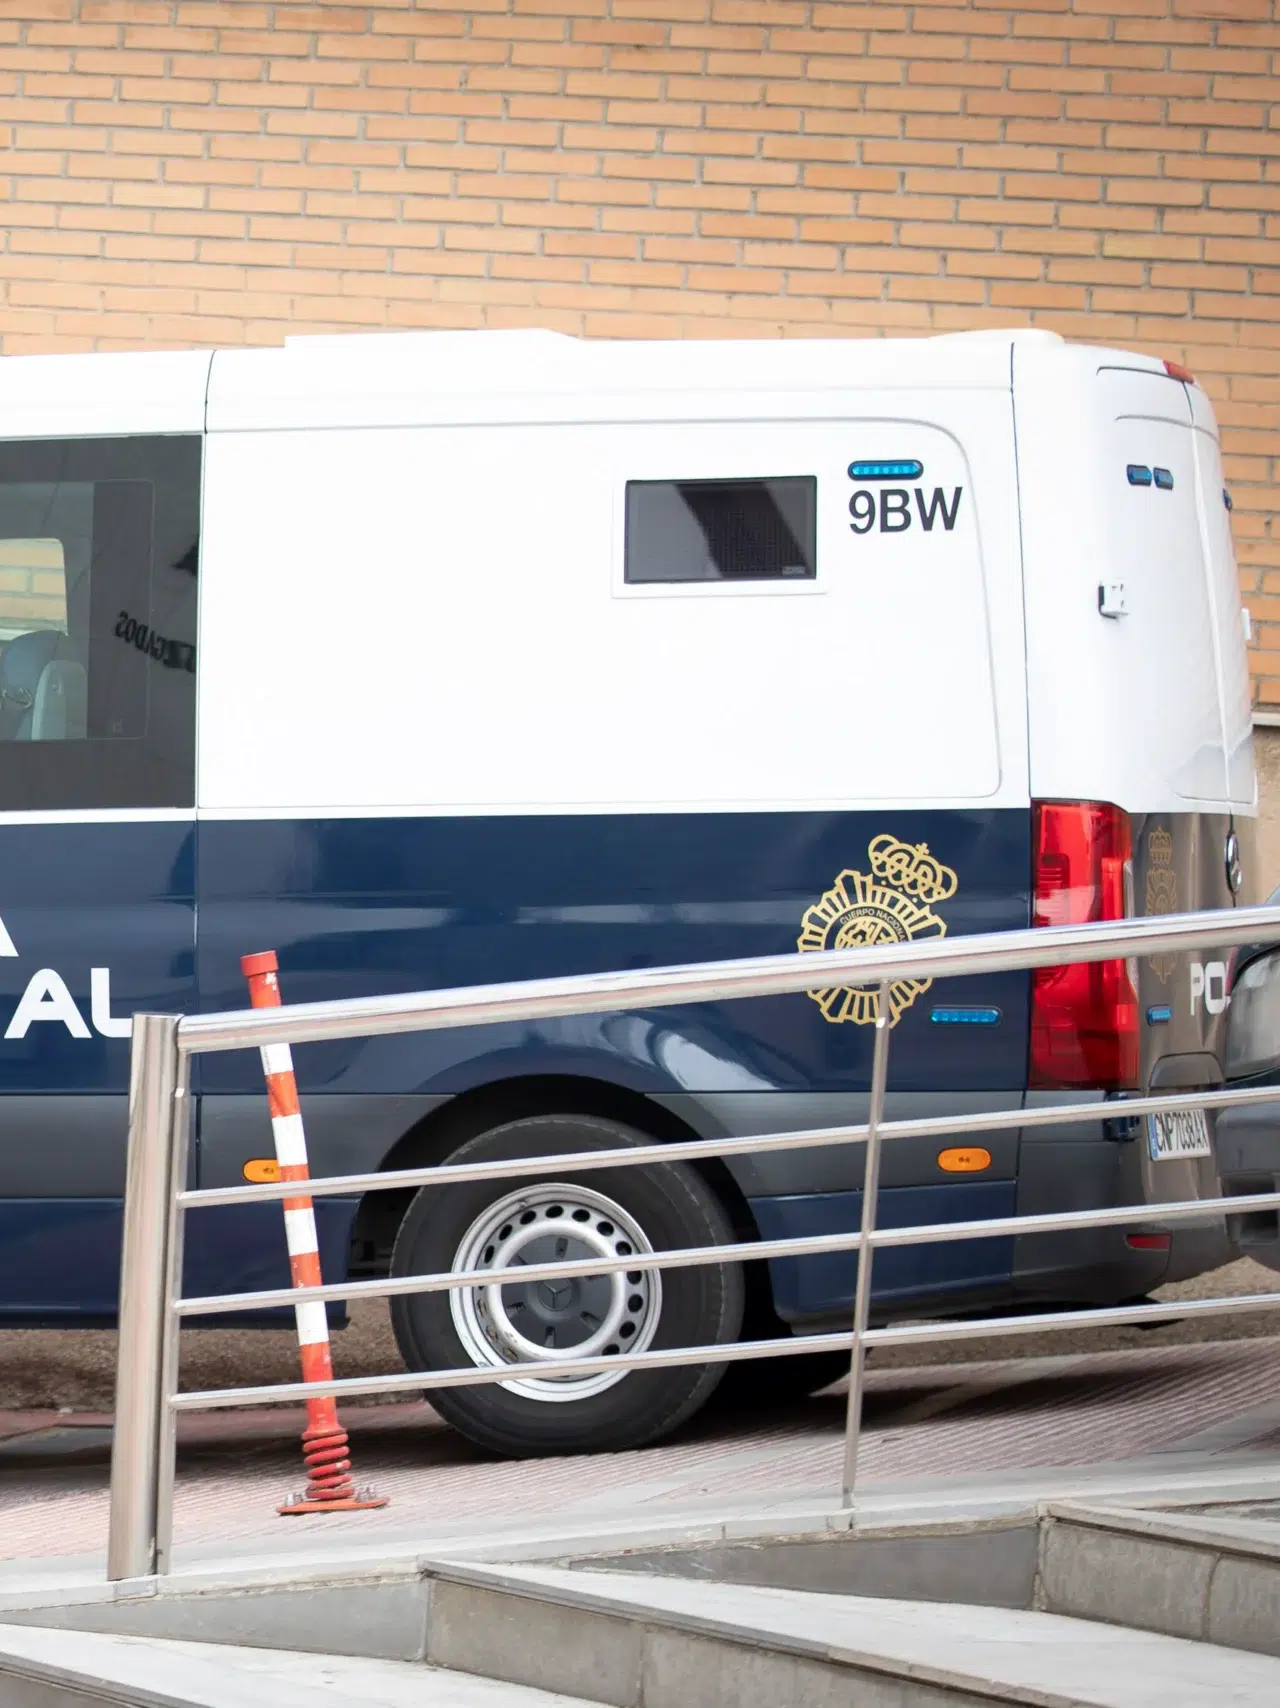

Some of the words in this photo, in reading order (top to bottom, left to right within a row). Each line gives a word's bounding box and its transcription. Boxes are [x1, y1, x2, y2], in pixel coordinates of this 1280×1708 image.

[849, 487, 963, 534] 9BW
[840, 907, 875, 925] CUERPO
[875, 909, 907, 942] NACIONA
